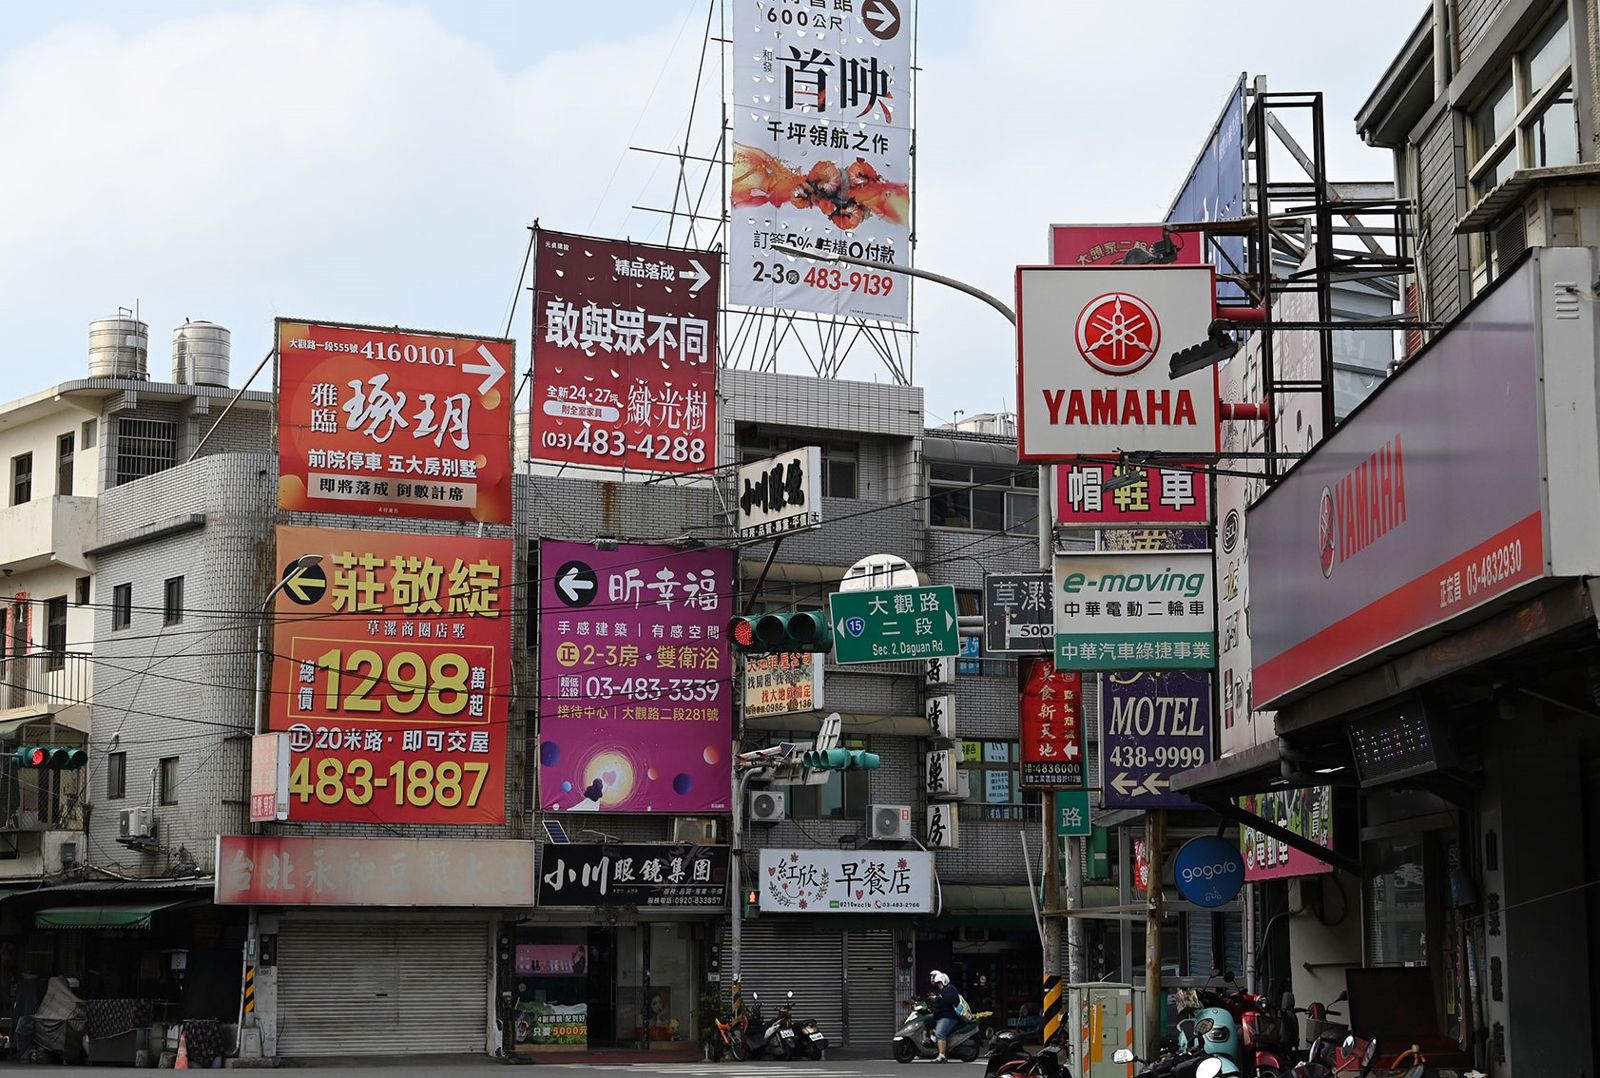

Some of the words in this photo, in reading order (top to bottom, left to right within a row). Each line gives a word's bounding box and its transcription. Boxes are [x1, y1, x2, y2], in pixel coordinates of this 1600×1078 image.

[762, 50, 773, 72] 和發
[776, 45, 894, 124] 首映
[767, 121, 889, 155] 千坪領航之作
[615, 259, 675, 281] 精品落成
[803, 266, 894, 297] 483-9139
[545, 301, 709, 363] 敢與眾不同
[360, 340, 456, 367] 4160101
[311, 383, 338, 433] 雅臨
[625, 385, 708, 432] 織光樹
[1042, 389, 1197, 426] YAMAHA
[542, 427, 705, 463] (03)483-4288
[308, 449, 382, 471] 前院停車
[388, 454, 477, 478] 五大房別墅
[320, 478, 389, 496] 即將落成
[1335, 432, 1407, 565] YAMAHA
[332, 551, 500, 618] 莊敬綻
[608, 566, 719, 612] 昕幸福
[1063, 567, 1205, 598] e-moving
[1439, 571, 1461, 608] 正宏昌
[1466, 539, 1522, 597] 03-4832930
[868, 592, 940, 616] 大觀路
[993, 581, 1054, 612] 草漯
[1064, 600, 1205, 617] 中華電動二輪車
[367, 620, 466, 639] 草漯商圈店墅
[849, 621, 861, 632] 15
[882, 617, 934, 636] 二段
[1020, 625, 1054, 638] 500
[872, 644, 890, 657] Sec.
[900, 642, 930, 657] Daguan
[931, 639, 945, 652] Rd.
[1061, 641, 1211, 661] 中華汽車綠捷事業
[298, 659, 315, 711] 總價
[318, 649, 470, 715] 1298
[468, 666, 486, 717] 萬起
[586, 676, 719, 701] 03-483-3339
[622, 706, 719, 721] 大觀路二段281號
[1109, 697, 1205, 736] MOTEL
[1110, 745, 1205, 768] 438-9999
[289, 757, 490, 807] 483-1887
[1062, 808, 1082, 827] 路
[778, 858, 819, 887] 紅欣
[835, 861, 911, 897] 早餐店
[1182, 861, 1237, 883] gogoro
